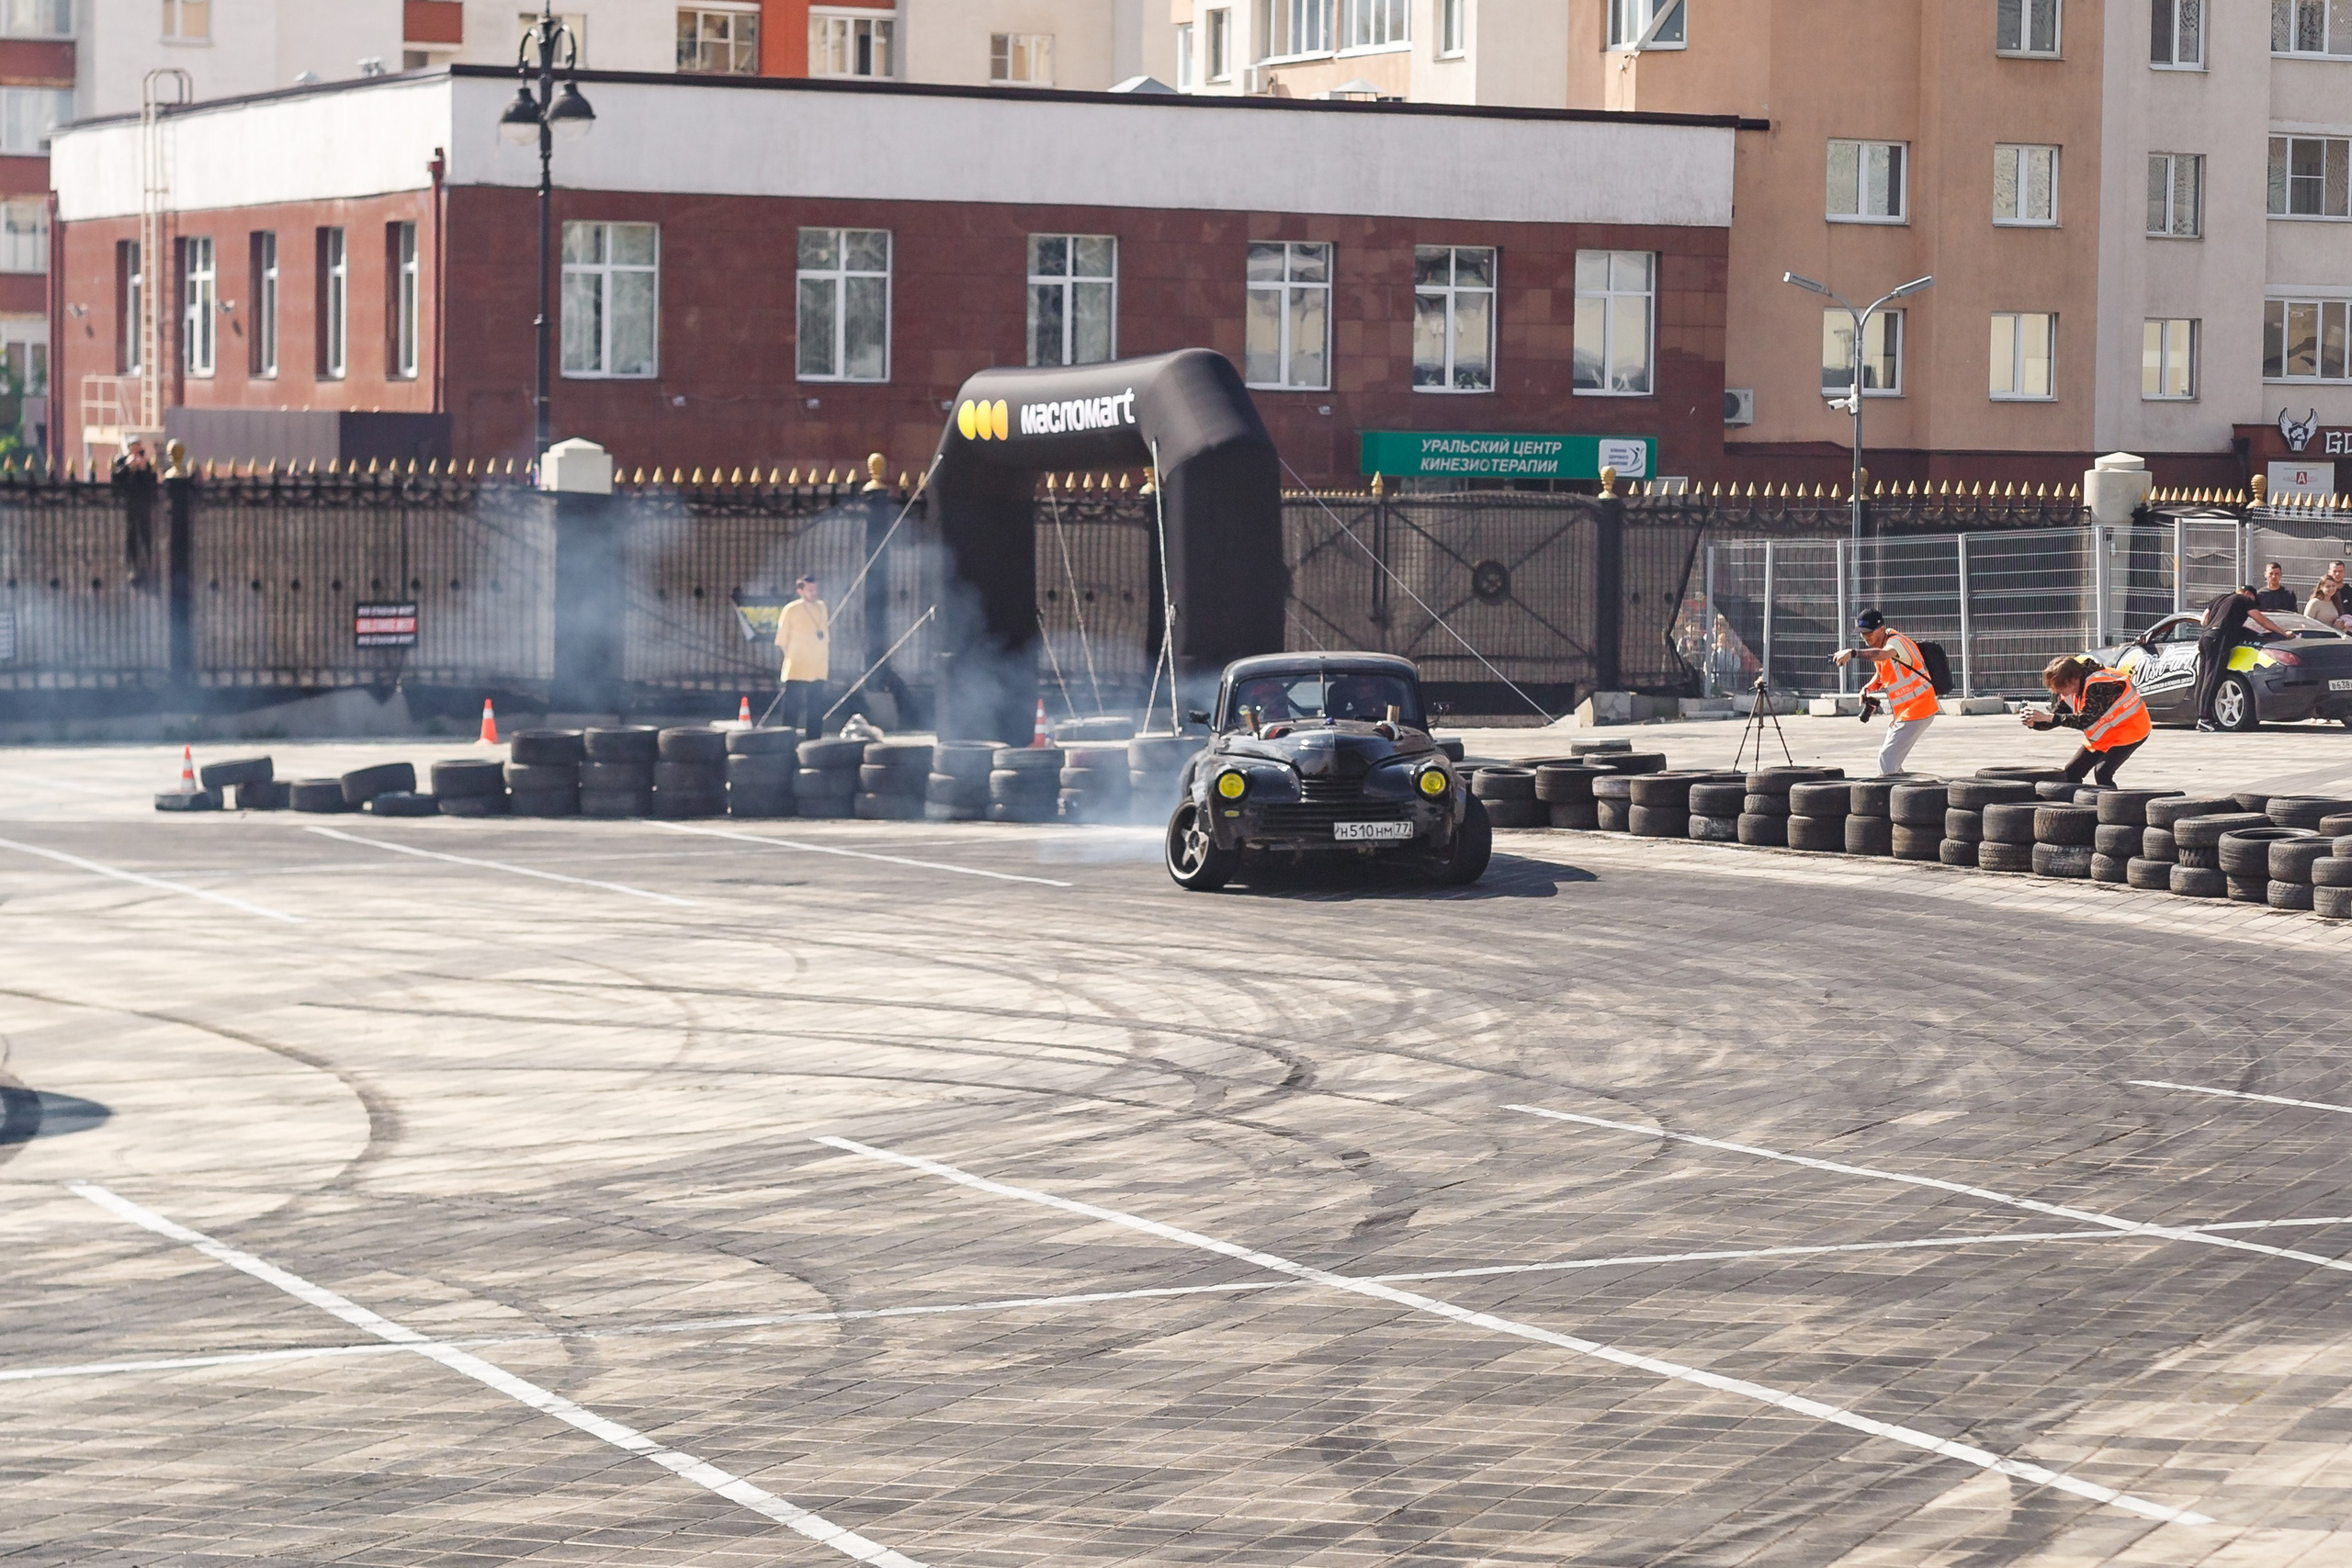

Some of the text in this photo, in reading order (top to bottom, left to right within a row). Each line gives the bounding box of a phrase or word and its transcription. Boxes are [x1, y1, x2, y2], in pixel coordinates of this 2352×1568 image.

[1421, 438, 1562, 457] УРАЛЬСКИЙ ЦЕНТР
[1420, 457, 1558, 473] КИНЕЗИОТЕРАПИИ
